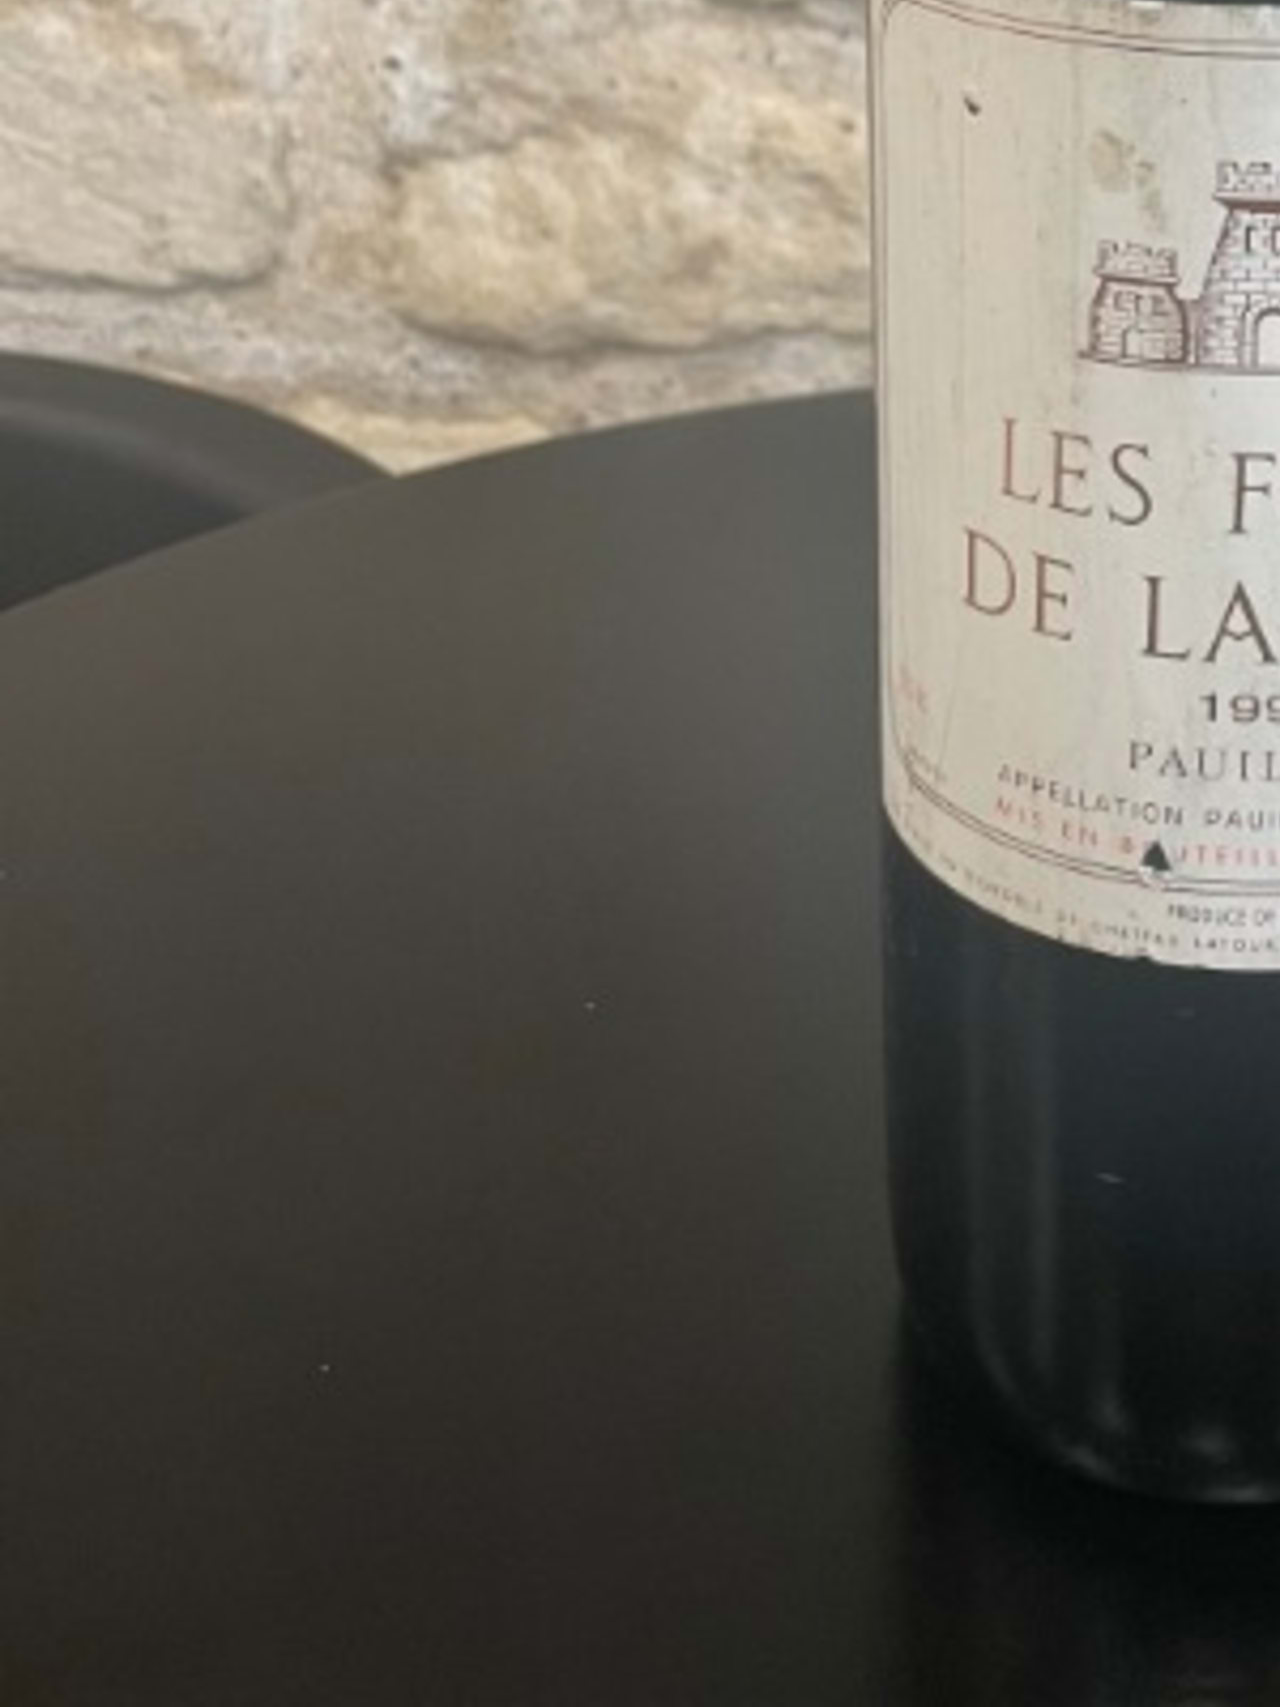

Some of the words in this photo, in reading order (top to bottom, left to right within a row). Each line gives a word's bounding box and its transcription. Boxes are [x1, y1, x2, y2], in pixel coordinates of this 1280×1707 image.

[1001, 416, 1153, 526] LES
[961, 527, 1075, 642] DE
[994, 795, 1043, 829] MIS
[1061, 820, 1099, 846] EN
[997, 764, 1183, 826] APPELLATION
